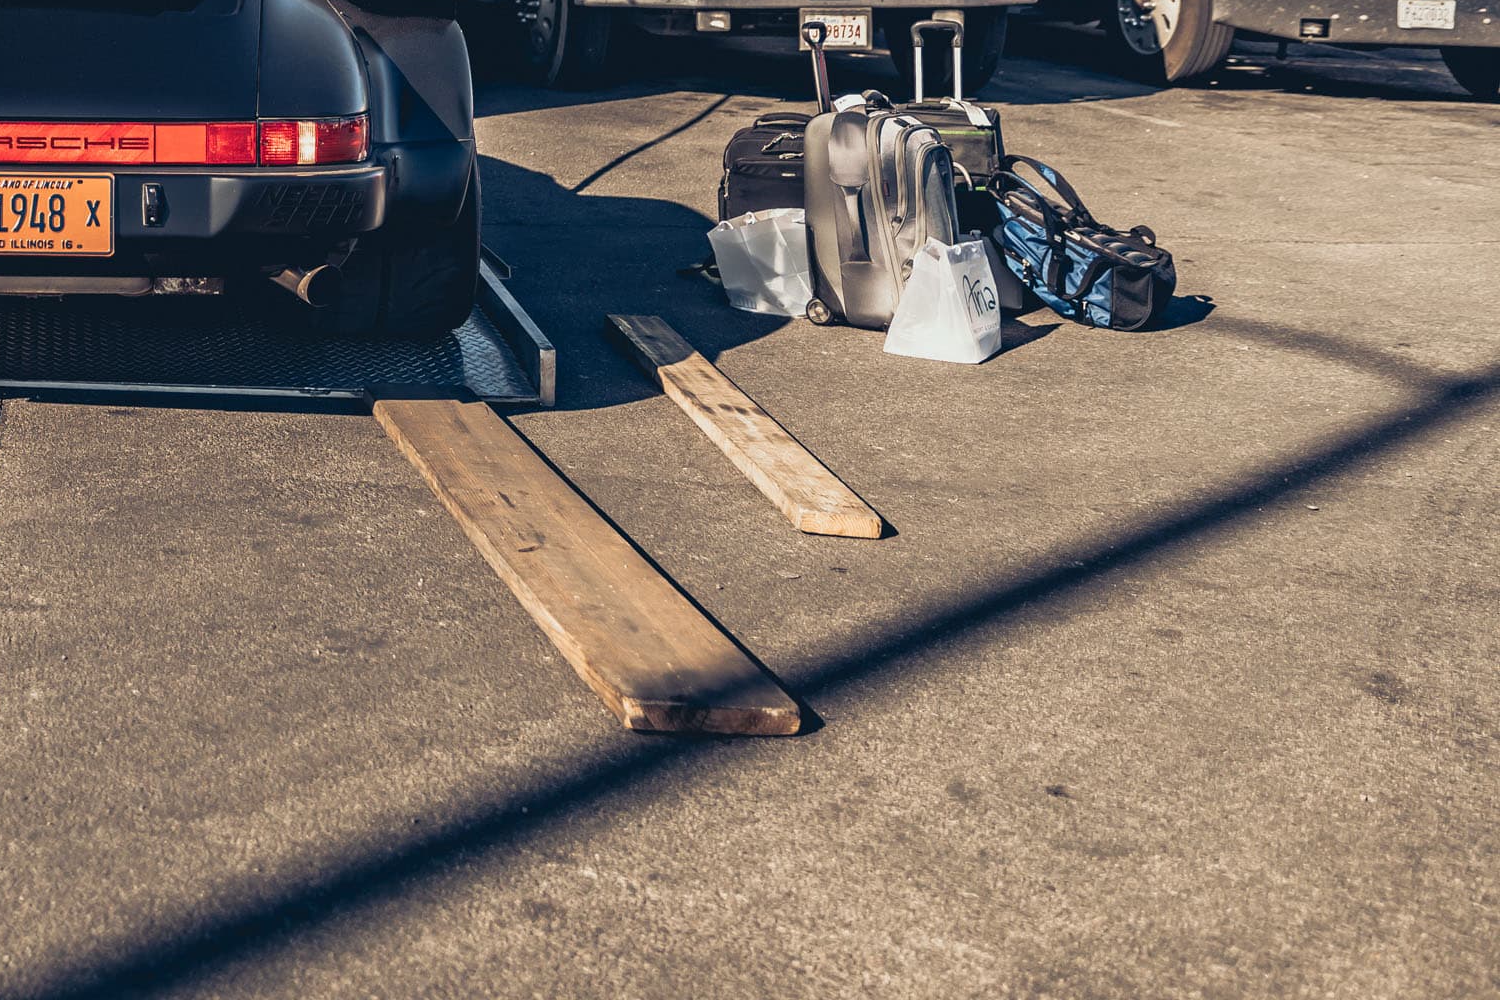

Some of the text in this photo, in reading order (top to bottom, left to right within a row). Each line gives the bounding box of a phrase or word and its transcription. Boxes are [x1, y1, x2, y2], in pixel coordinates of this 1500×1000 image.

[22, 180, 34, 189] OF
[35, 180, 73, 190] LINCOLN
[86, 200, 101, 227] X
[10, 240, 54, 250] ILLINOIS
[61, 240, 73, 250] 16
[963, 275, 996, 323] Aria
